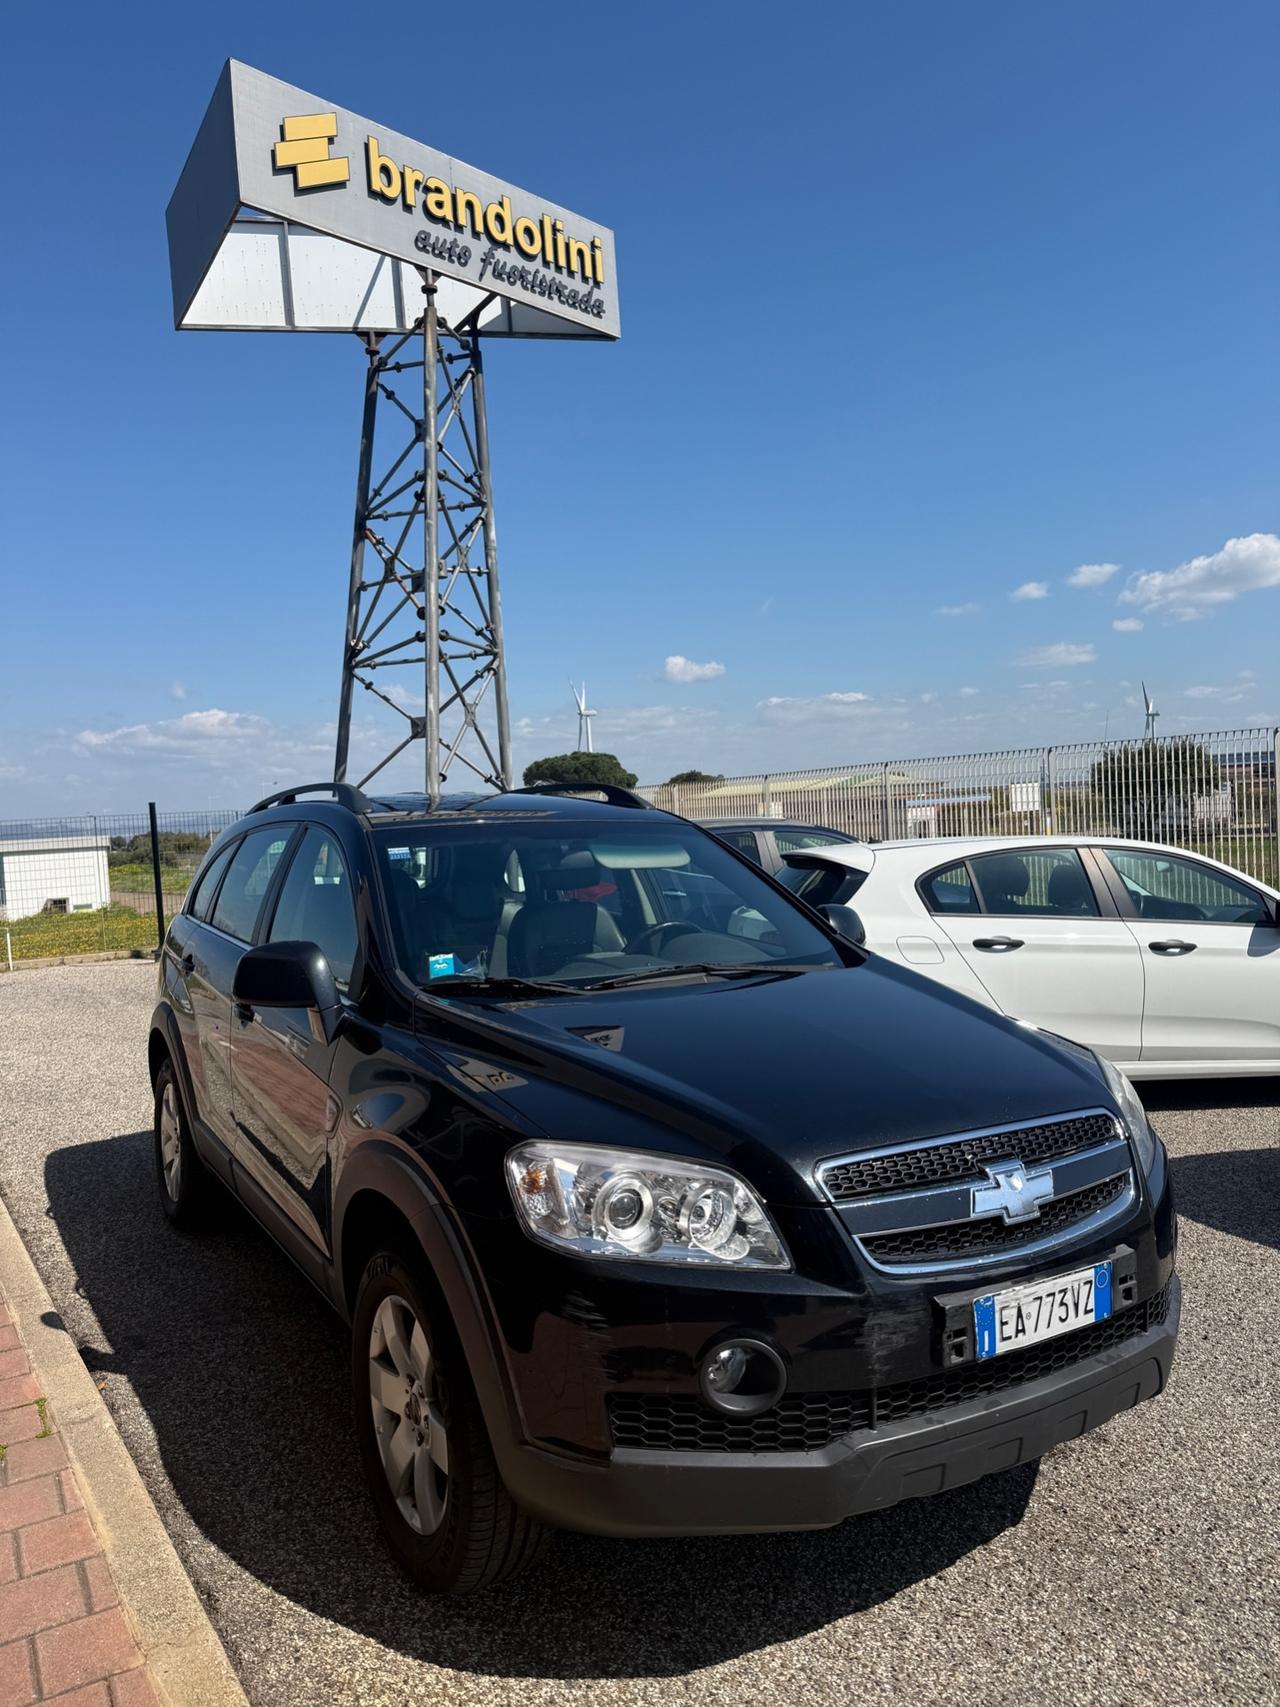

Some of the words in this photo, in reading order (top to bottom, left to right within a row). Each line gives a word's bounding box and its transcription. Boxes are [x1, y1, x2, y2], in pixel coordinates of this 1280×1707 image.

[365, 135, 604, 285] brandolini
[414, 229, 472, 268] auto
[478, 244, 606, 319] fuoristrada
